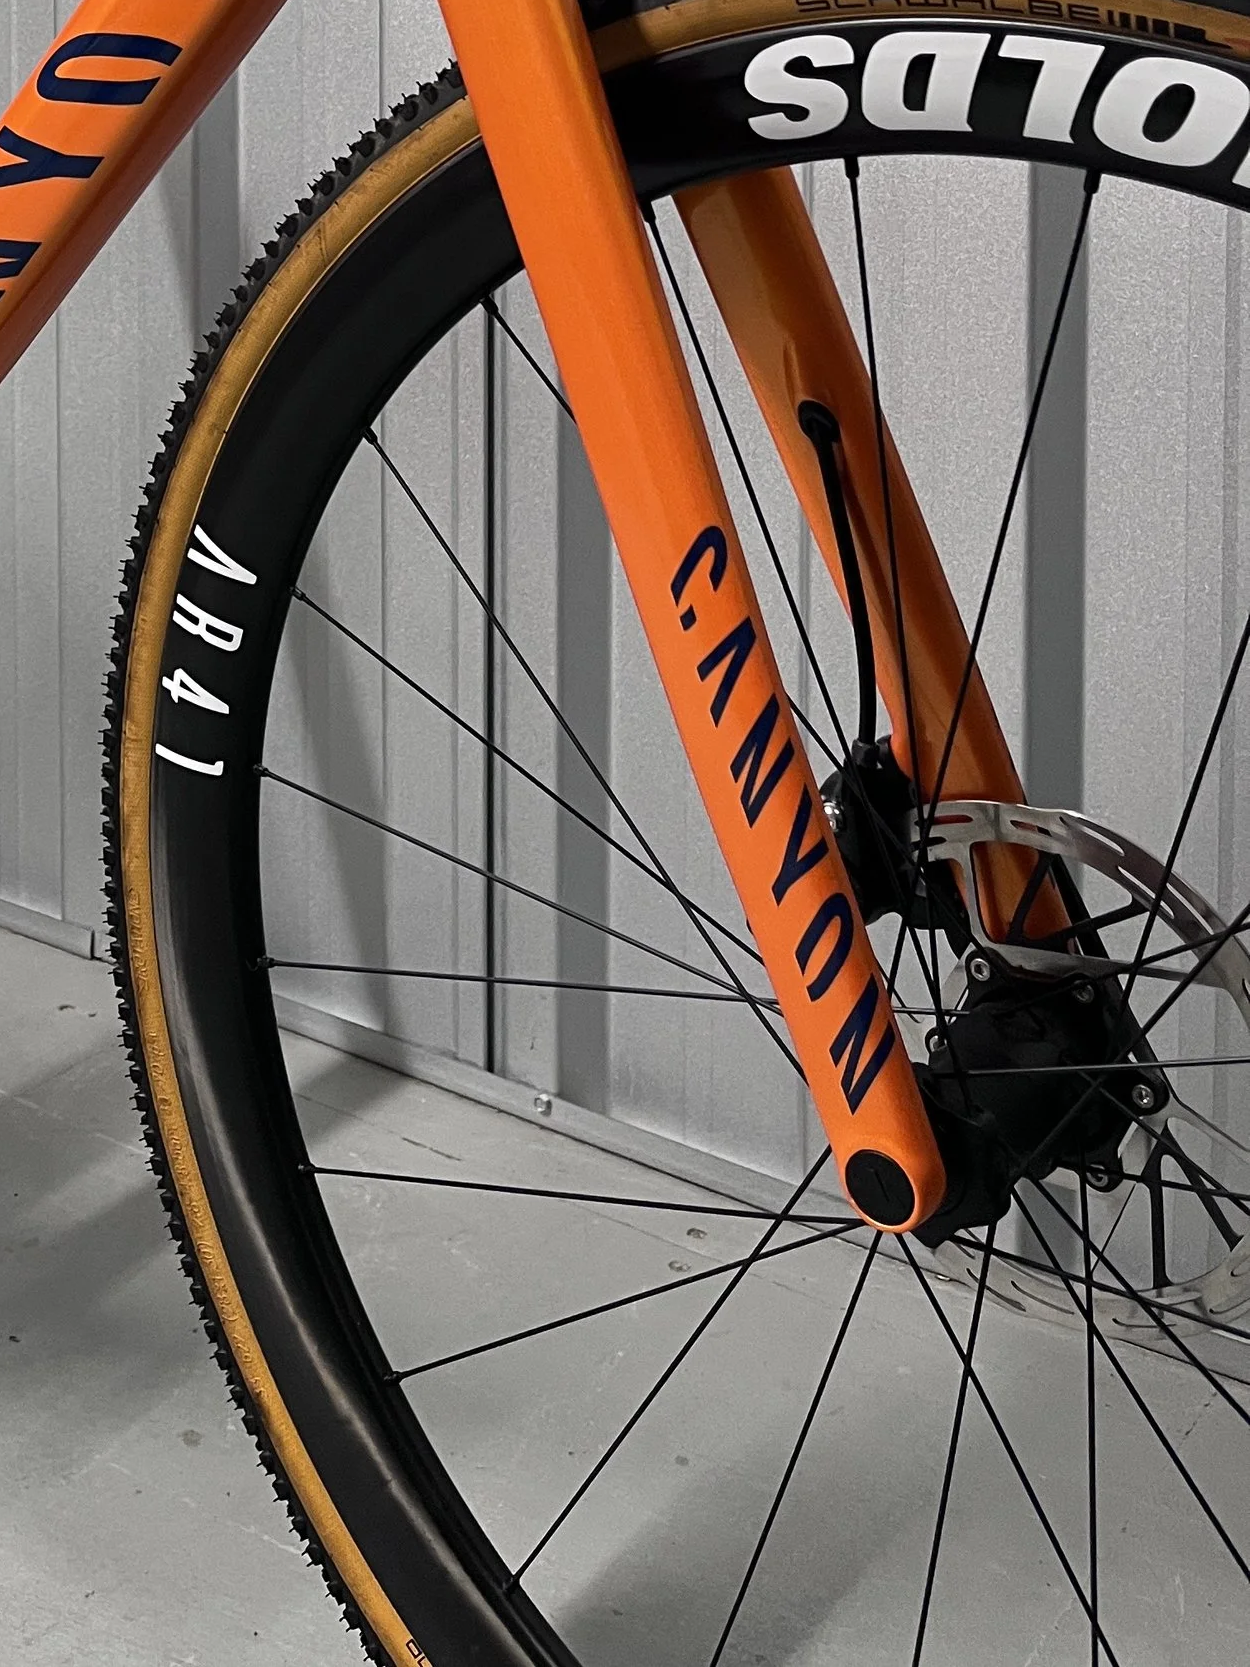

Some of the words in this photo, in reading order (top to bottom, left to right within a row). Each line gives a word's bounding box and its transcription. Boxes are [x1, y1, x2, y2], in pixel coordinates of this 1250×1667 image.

[744, 31, 1250, 187] OLDS
[154, 523, 259, 778] AR41
[670, 524, 897, 1117] CANYON
